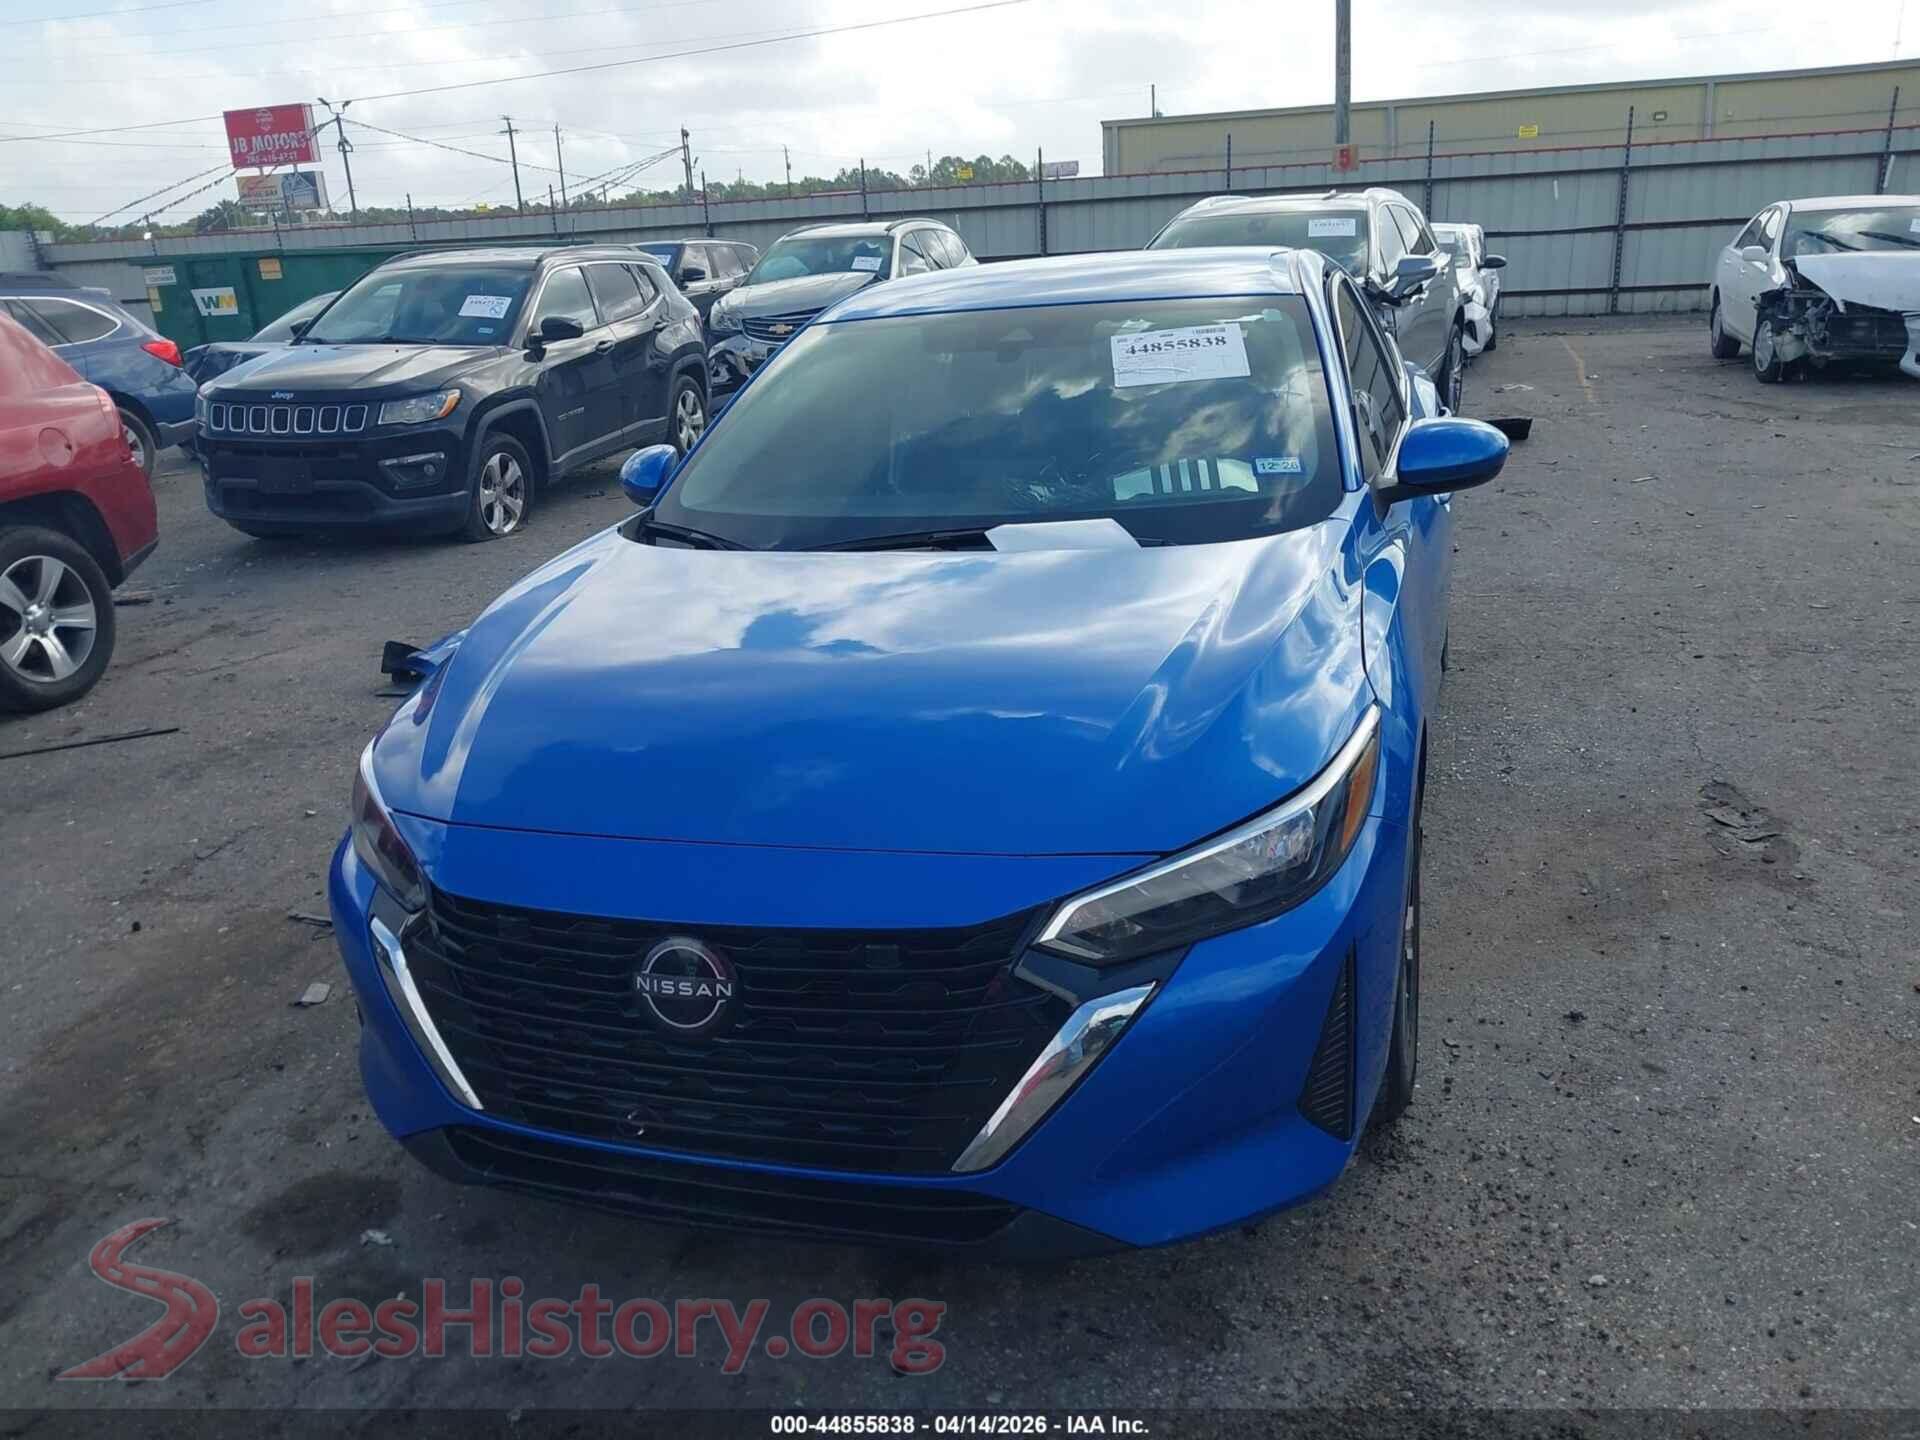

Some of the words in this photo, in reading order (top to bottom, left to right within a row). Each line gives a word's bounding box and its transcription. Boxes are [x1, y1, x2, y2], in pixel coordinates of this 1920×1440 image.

[232, 137, 249, 154] JB
[201, 295, 237, 309] WM
[1126, 336, 1227, 355] 44855838
[636, 975, 732, 997] NISSAN
